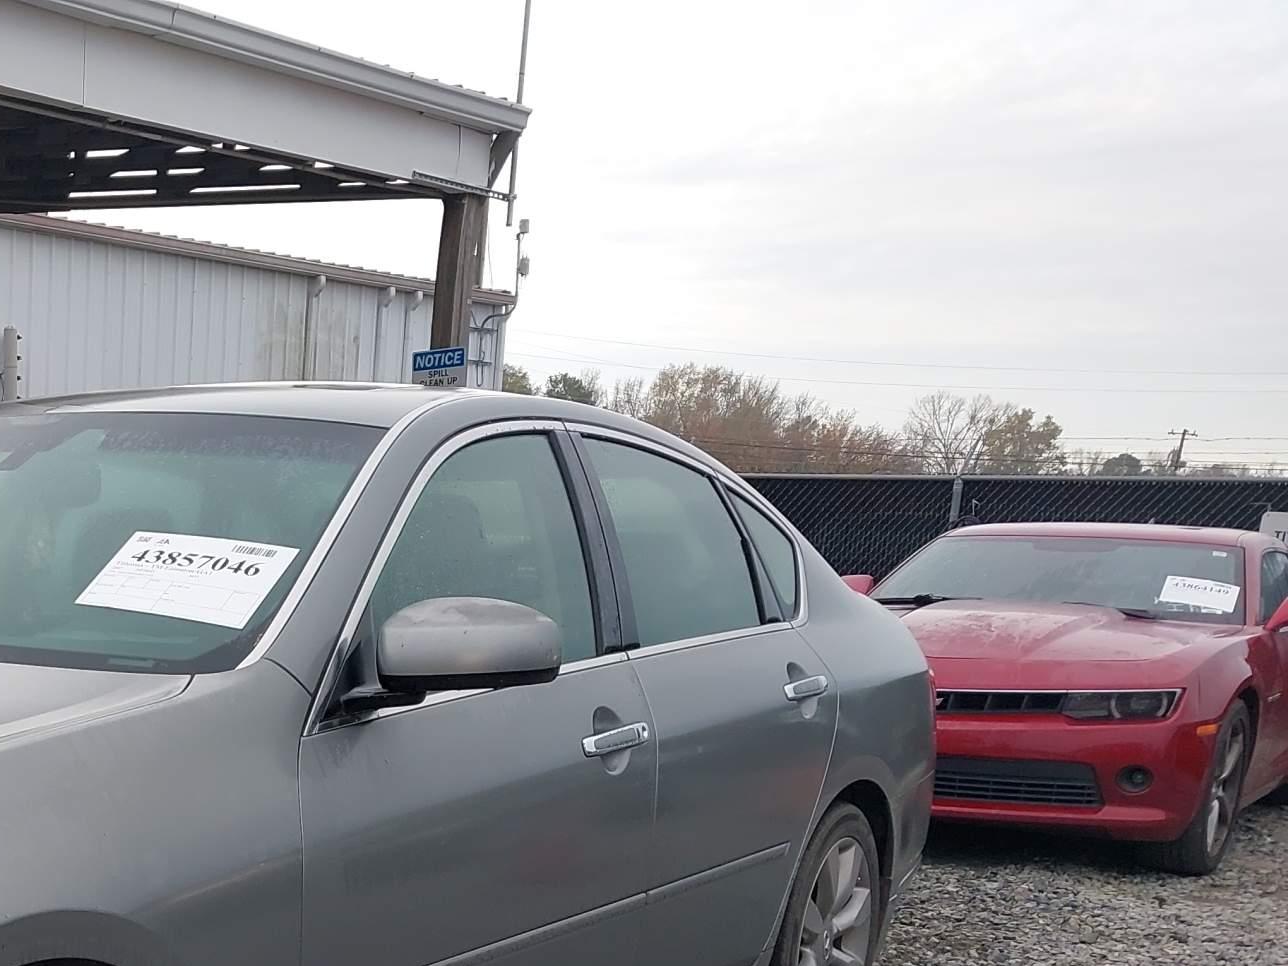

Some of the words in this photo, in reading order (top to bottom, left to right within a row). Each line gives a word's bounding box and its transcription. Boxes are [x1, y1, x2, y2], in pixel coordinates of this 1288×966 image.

[415, 350, 463, 369] NOTICE
[427, 368, 449, 379] SPILL
[447, 376, 458, 385] UP
[130, 548, 266, 577] 43857046
